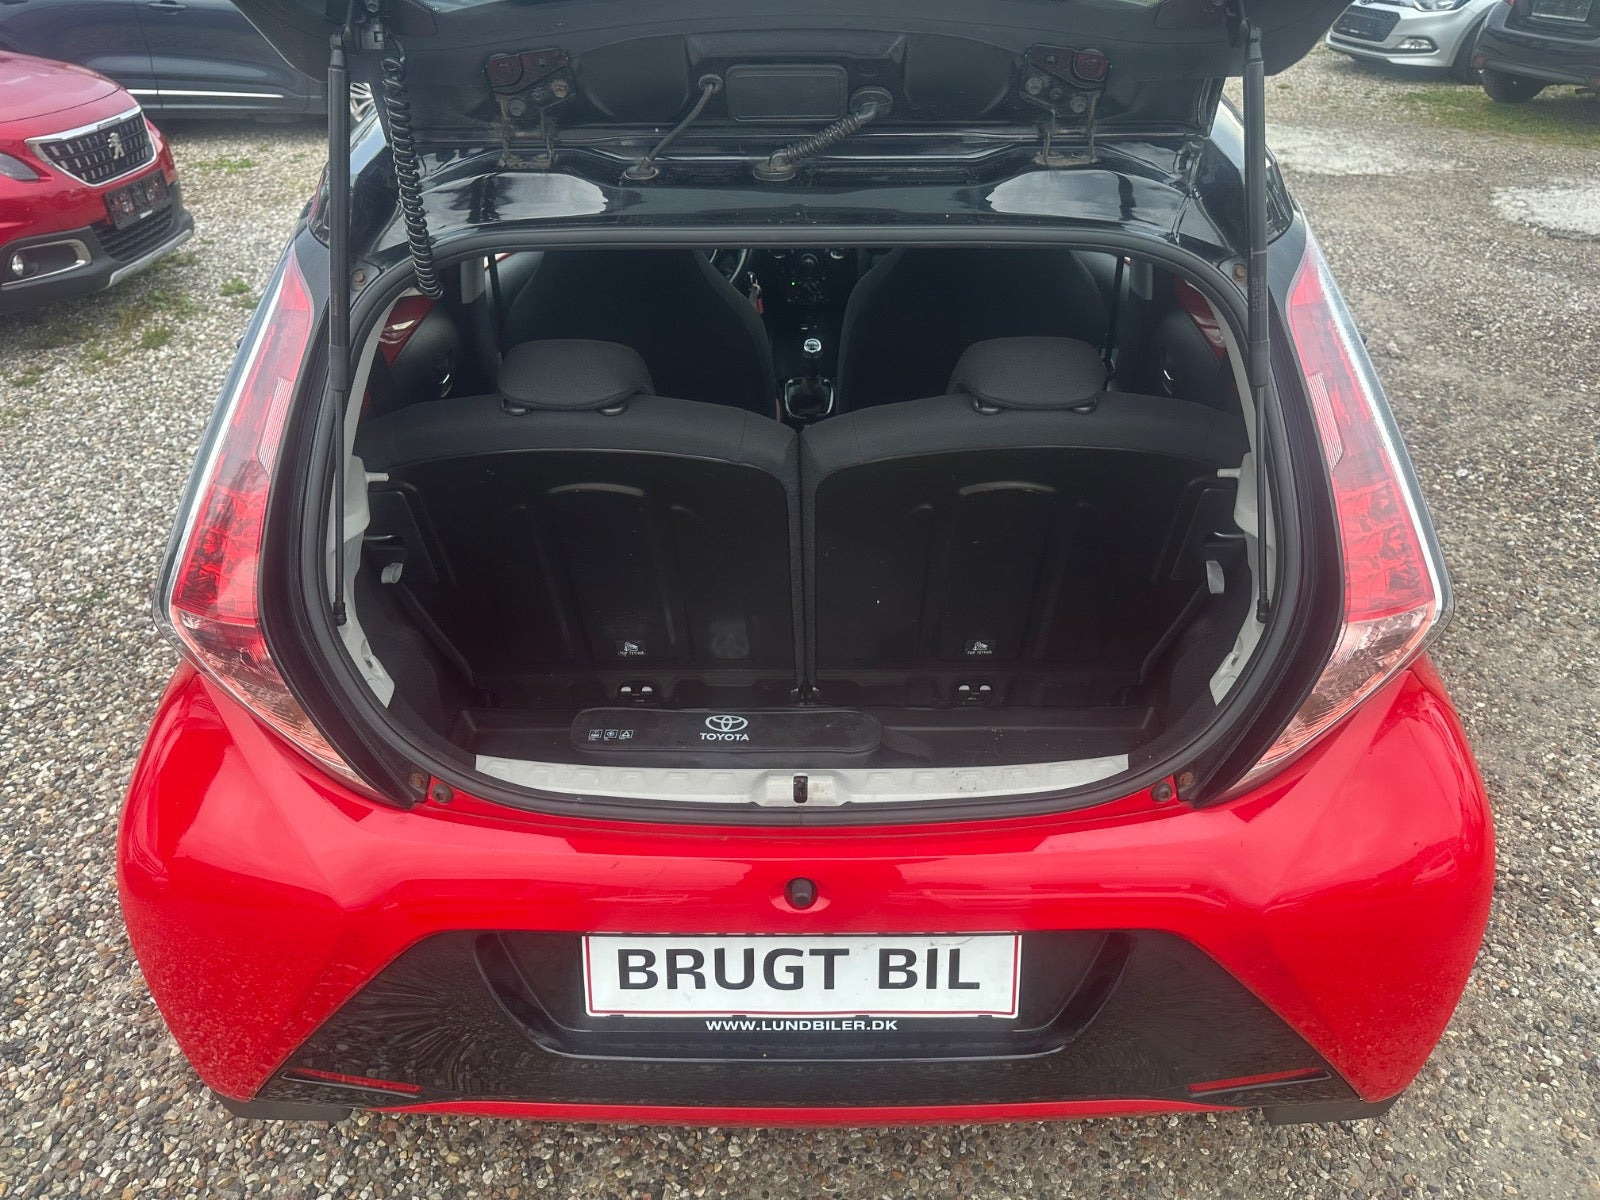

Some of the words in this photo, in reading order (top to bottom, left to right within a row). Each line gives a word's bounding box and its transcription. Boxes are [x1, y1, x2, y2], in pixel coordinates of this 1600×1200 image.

[700, 732, 750, 741] TOYOTA
[618, 948, 849, 990] BRUGT
[879, 948, 980, 990] BIL
[706, 1020, 898, 1031] WWW.LUNDBILER.DK
